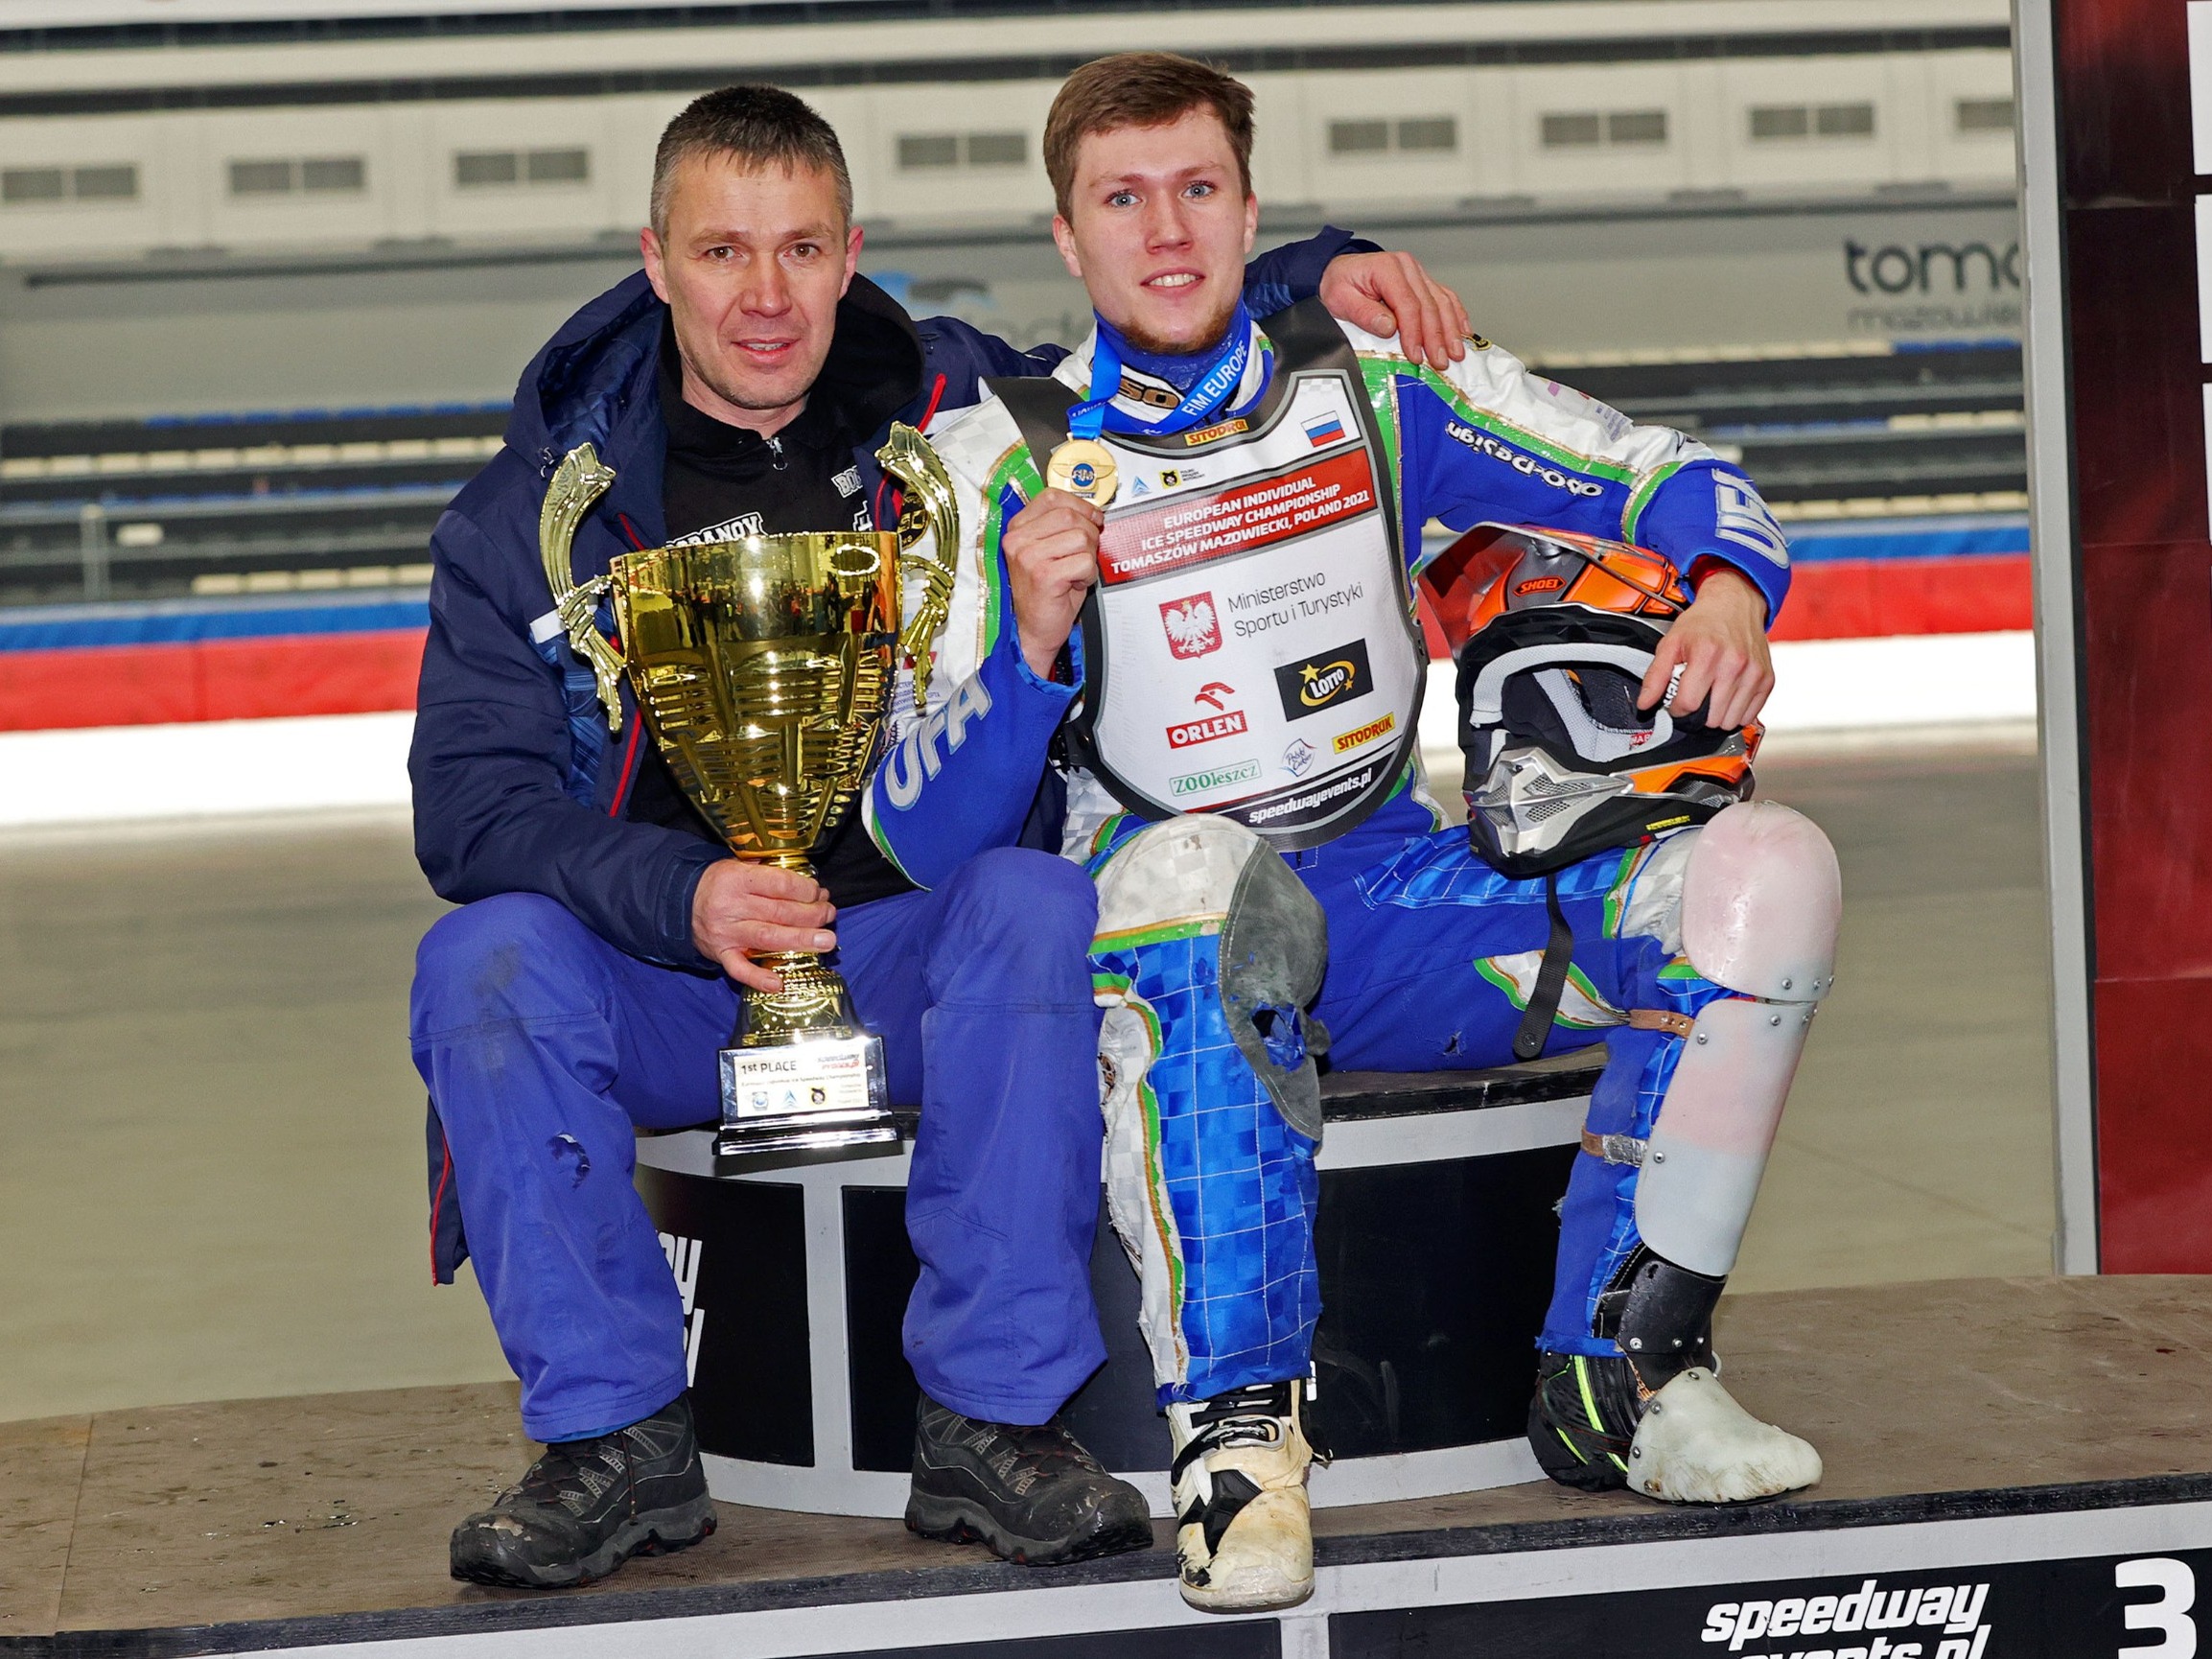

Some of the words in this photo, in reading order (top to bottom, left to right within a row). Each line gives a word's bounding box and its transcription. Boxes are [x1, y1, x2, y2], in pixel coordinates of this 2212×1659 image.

[1181, 393, 1206, 416] FIM
[1204, 340, 1247, 398] EUROPE
[1142, 535, 1164, 550] ICE
[1166, 513, 1243, 545] SPEEDWAY
[1245, 483, 1340, 524] CHAMPIONSHIP
[1164, 499, 1242, 528] EUROPEAN
[1243, 477, 1316, 508] INDIVIDUAL
[1111, 543, 1198, 573] TOMASZÓW
[1199, 517, 1292, 551] MAZOWIECKI,
[1293, 500, 1342, 526] POLAND
[1342, 490, 1370, 508] 2021
[1228, 572, 1326, 613] Ministerstwo
[1234, 608, 1289, 638] Sportu
[1292, 604, 1297, 621] i
[1298, 581, 1364, 617] Turystyki
[1521, 578, 1560, 595] SHOEI
[1309, 668, 1344, 698] LOTTO
[885, 670, 992, 811] UFA
[1171, 714, 1243, 745] ORLEN
[1337, 716, 1392, 750] SITODRUK
[1248, 768, 1372, 824] speedwayevents.pl
[741, 1063, 757, 1074] 1st
[760, 1061, 797, 1072] PLACE
[1701, 1579, 1991, 1651] speedway
[2116, 1557, 2198, 1659] 3
